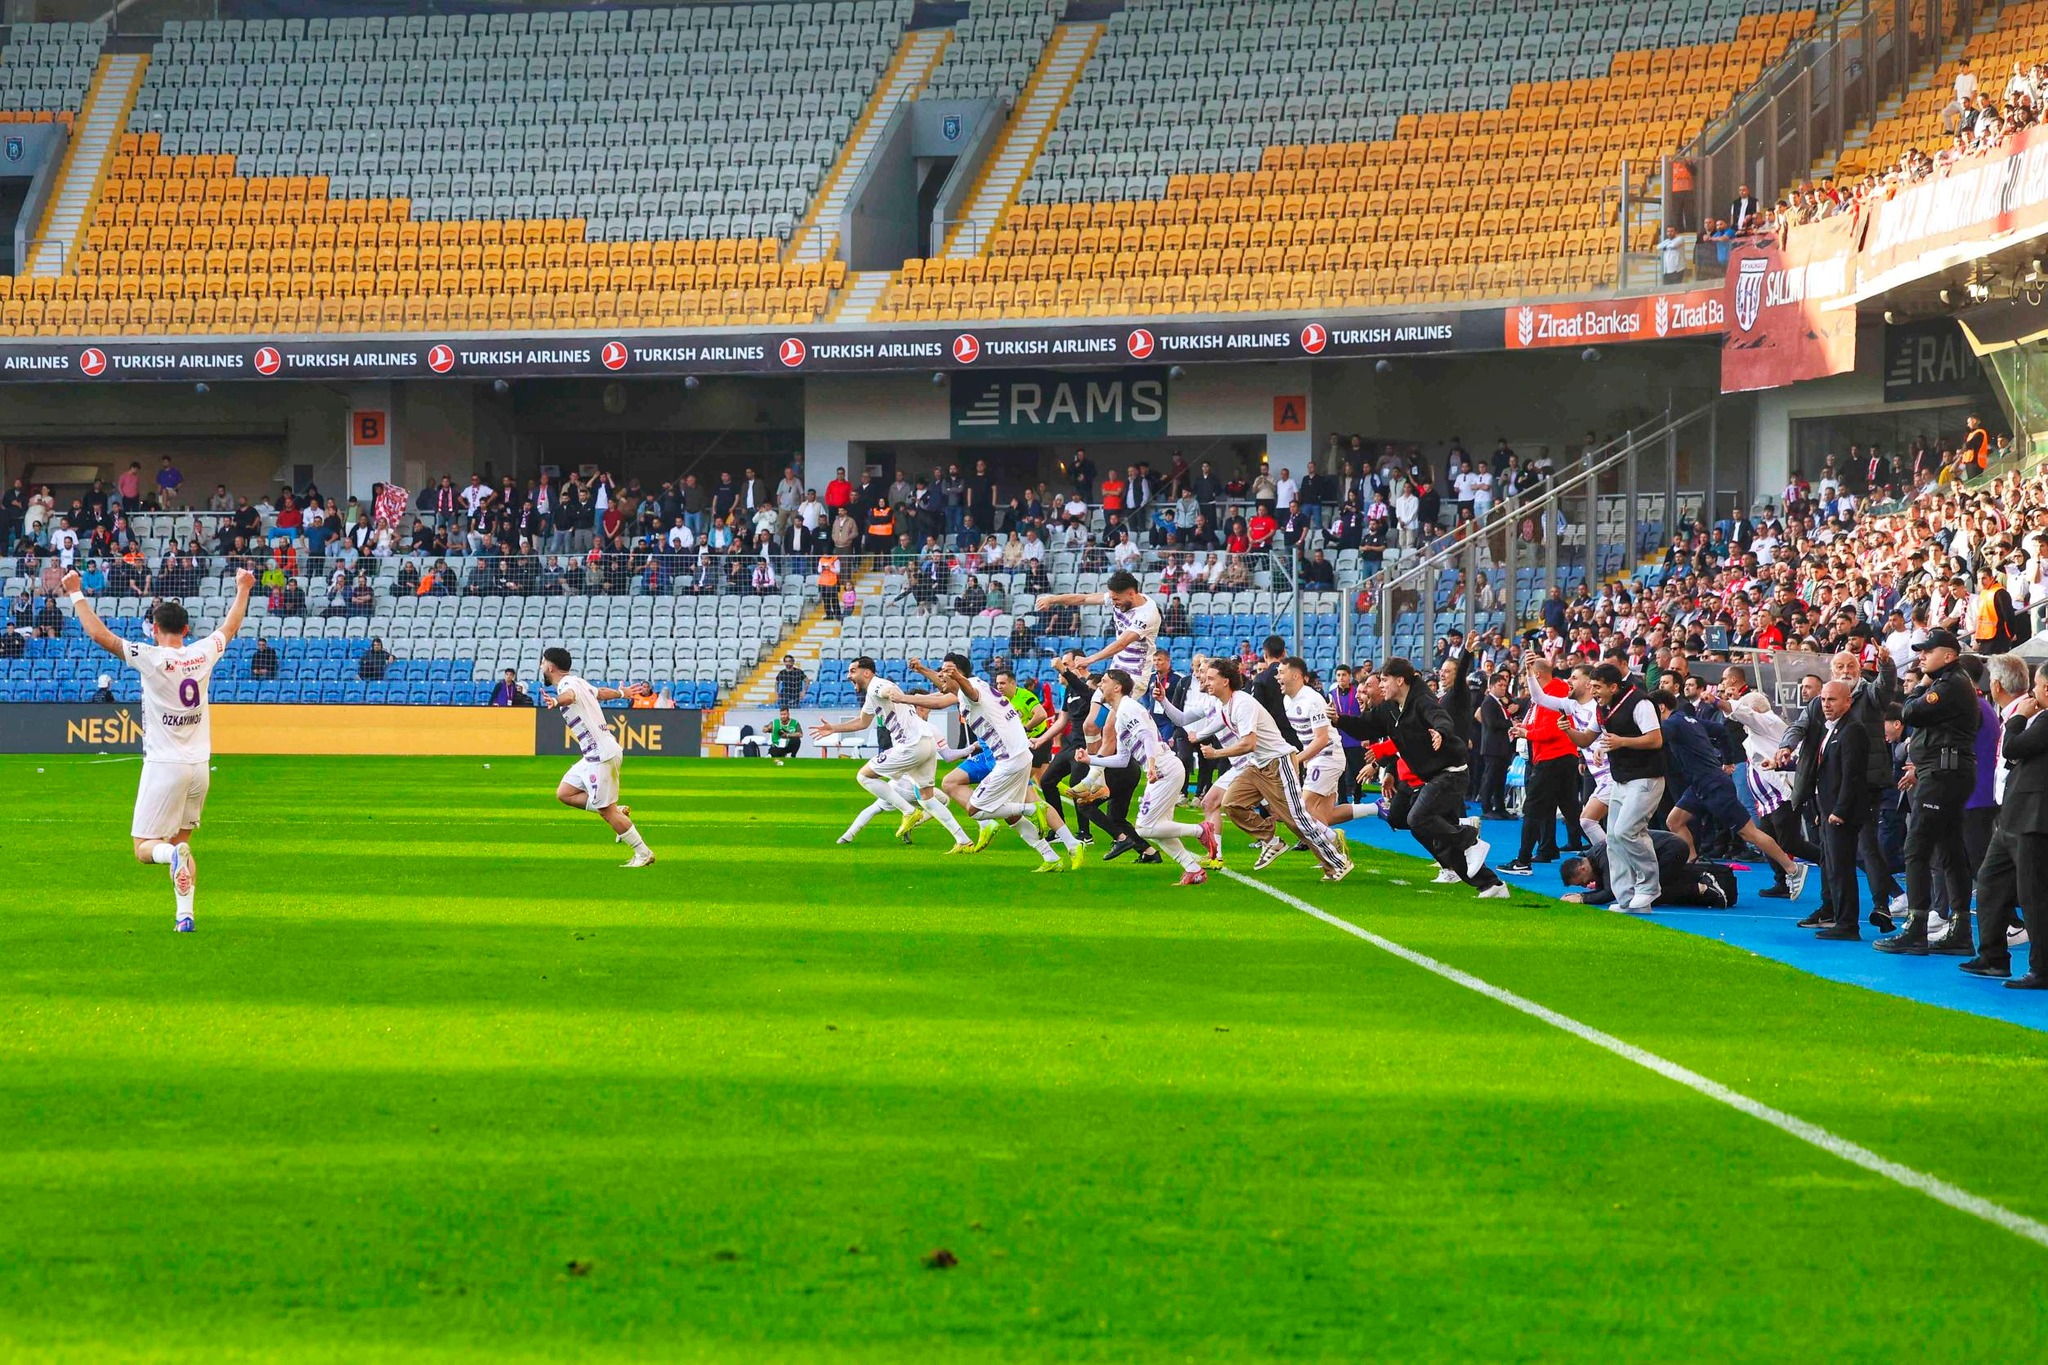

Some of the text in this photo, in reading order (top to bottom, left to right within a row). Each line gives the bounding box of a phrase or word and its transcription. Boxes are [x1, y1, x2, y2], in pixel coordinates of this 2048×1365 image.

[1537, 310, 1640, 338] Ziraat Bankası
[1671, 304, 1708, 328] Ziraat
[1159, 332, 1291, 350] TURKISH AIRLINES
[1331, 324, 1453, 345] TURKISH AIRLINES
[633, 346, 765, 362] TURKISH AIRLINES
[811, 342, 942, 359] TURKISH AIRLINES
[984, 338, 1117, 355] TURKISH AIRLINES
[4, 355, 69, 369] AIRLINES
[112, 354, 244, 369] TURKISH AIRLINES
[286, 352, 418, 367] TURKISH AIRLINES
[459, 349, 591, 365] TURKISH AIRLINES
[1917, 333, 1981, 383] RAM
[1010, 381, 1163, 425] RAMS
[1280, 402, 1299, 425] A
[362, 418, 378, 439] B
[1312, 713, 1326, 722] ATA
